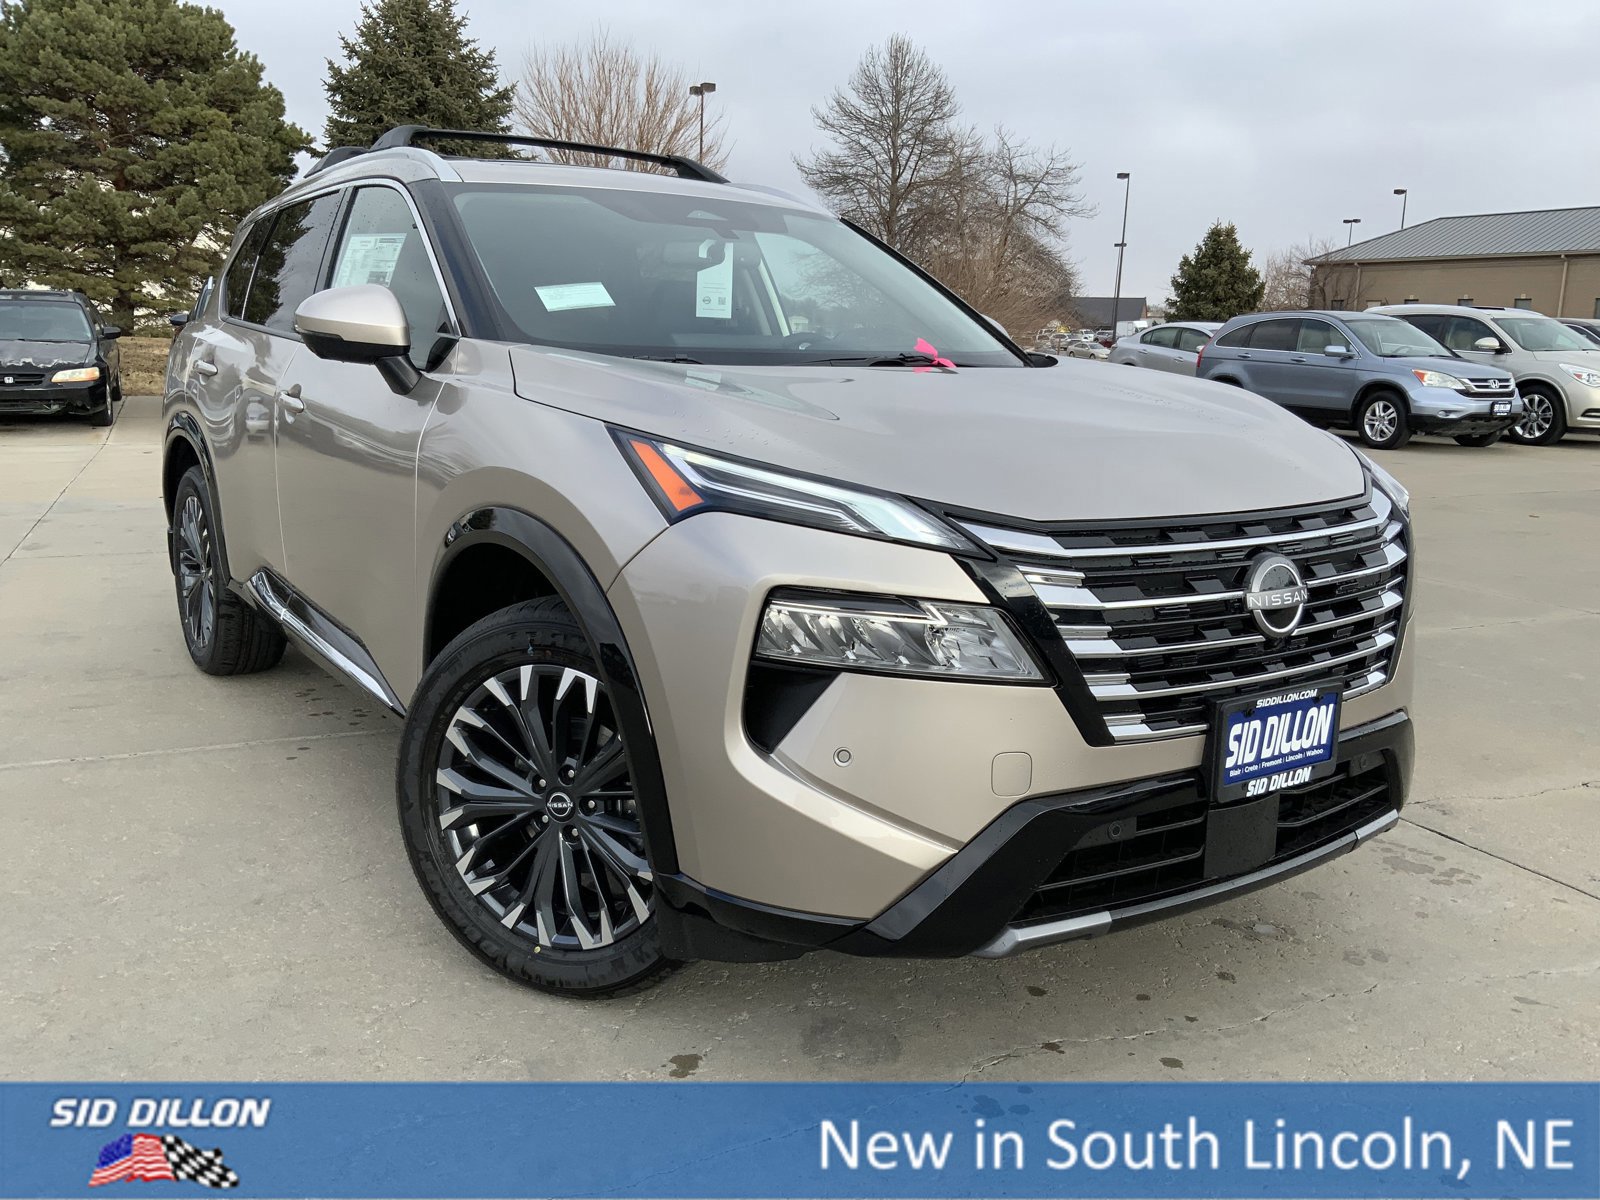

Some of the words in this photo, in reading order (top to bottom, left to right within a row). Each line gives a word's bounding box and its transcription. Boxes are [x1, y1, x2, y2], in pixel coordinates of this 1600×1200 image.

[1249, 588, 1308, 607] NISSAN
[1256, 689, 1318, 708] SIDDILLON.COM
[1225, 720, 1261, 768] SID
[1261, 704, 1334, 759] DILLON
[1229, 768, 1241, 777] Blair
[1245, 764, 1258, 773] Crete
[1261, 757, 1282, 768] Fremont
[1285, 752, 1303, 762] Lincoln
[1306, 748, 1324, 757] Wahoo
[1246, 777, 1267, 797] SID
[1269, 766, 1312, 792] DILLON
